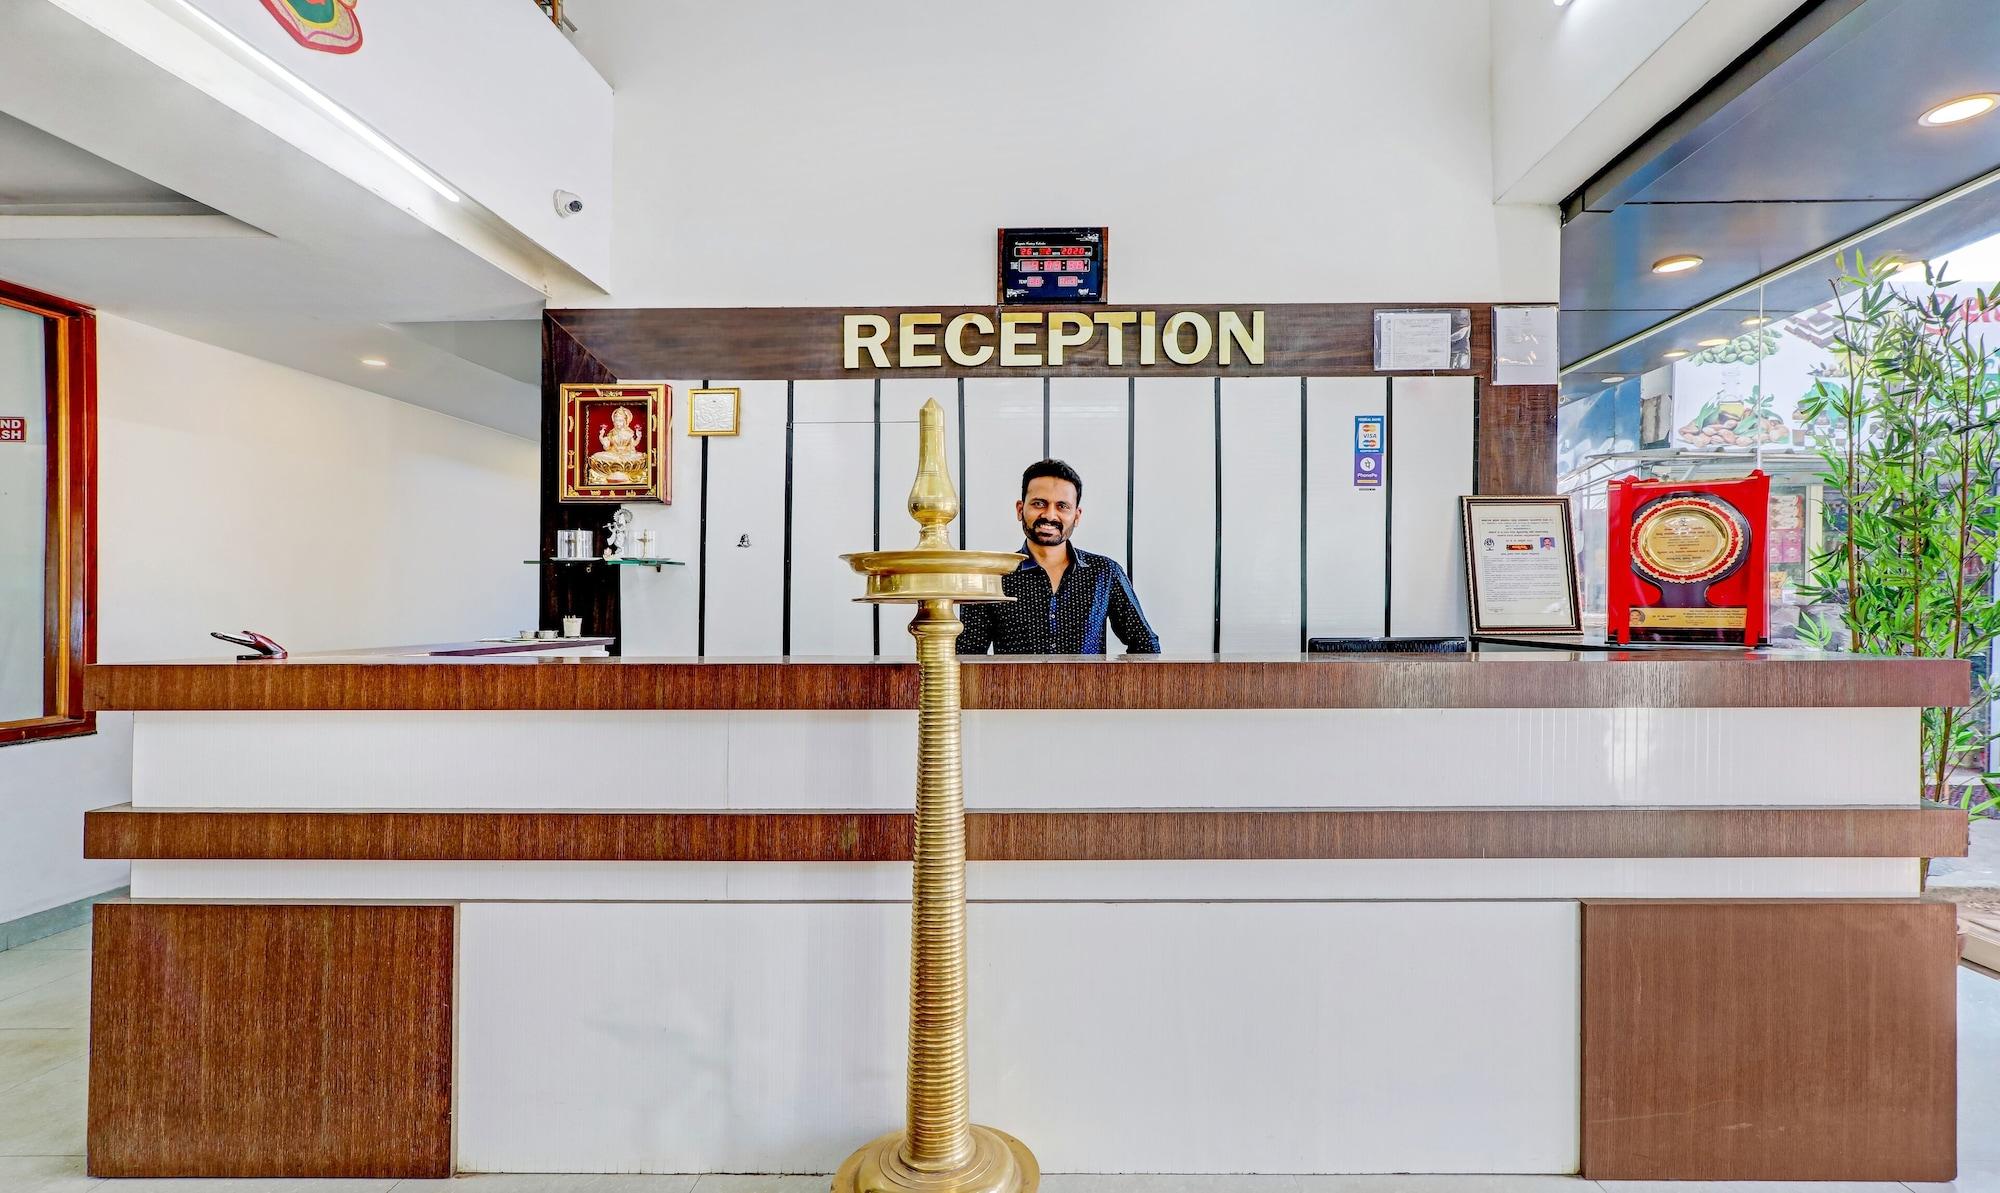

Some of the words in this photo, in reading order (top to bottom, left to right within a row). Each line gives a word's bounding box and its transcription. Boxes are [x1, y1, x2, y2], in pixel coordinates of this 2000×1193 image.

[1061, 247, 1085, 255] 2020
[843, 310, 1266, 370] RECEPTION
[0, 419, 21, 429] ND
[0, 429, 21, 440] SH
